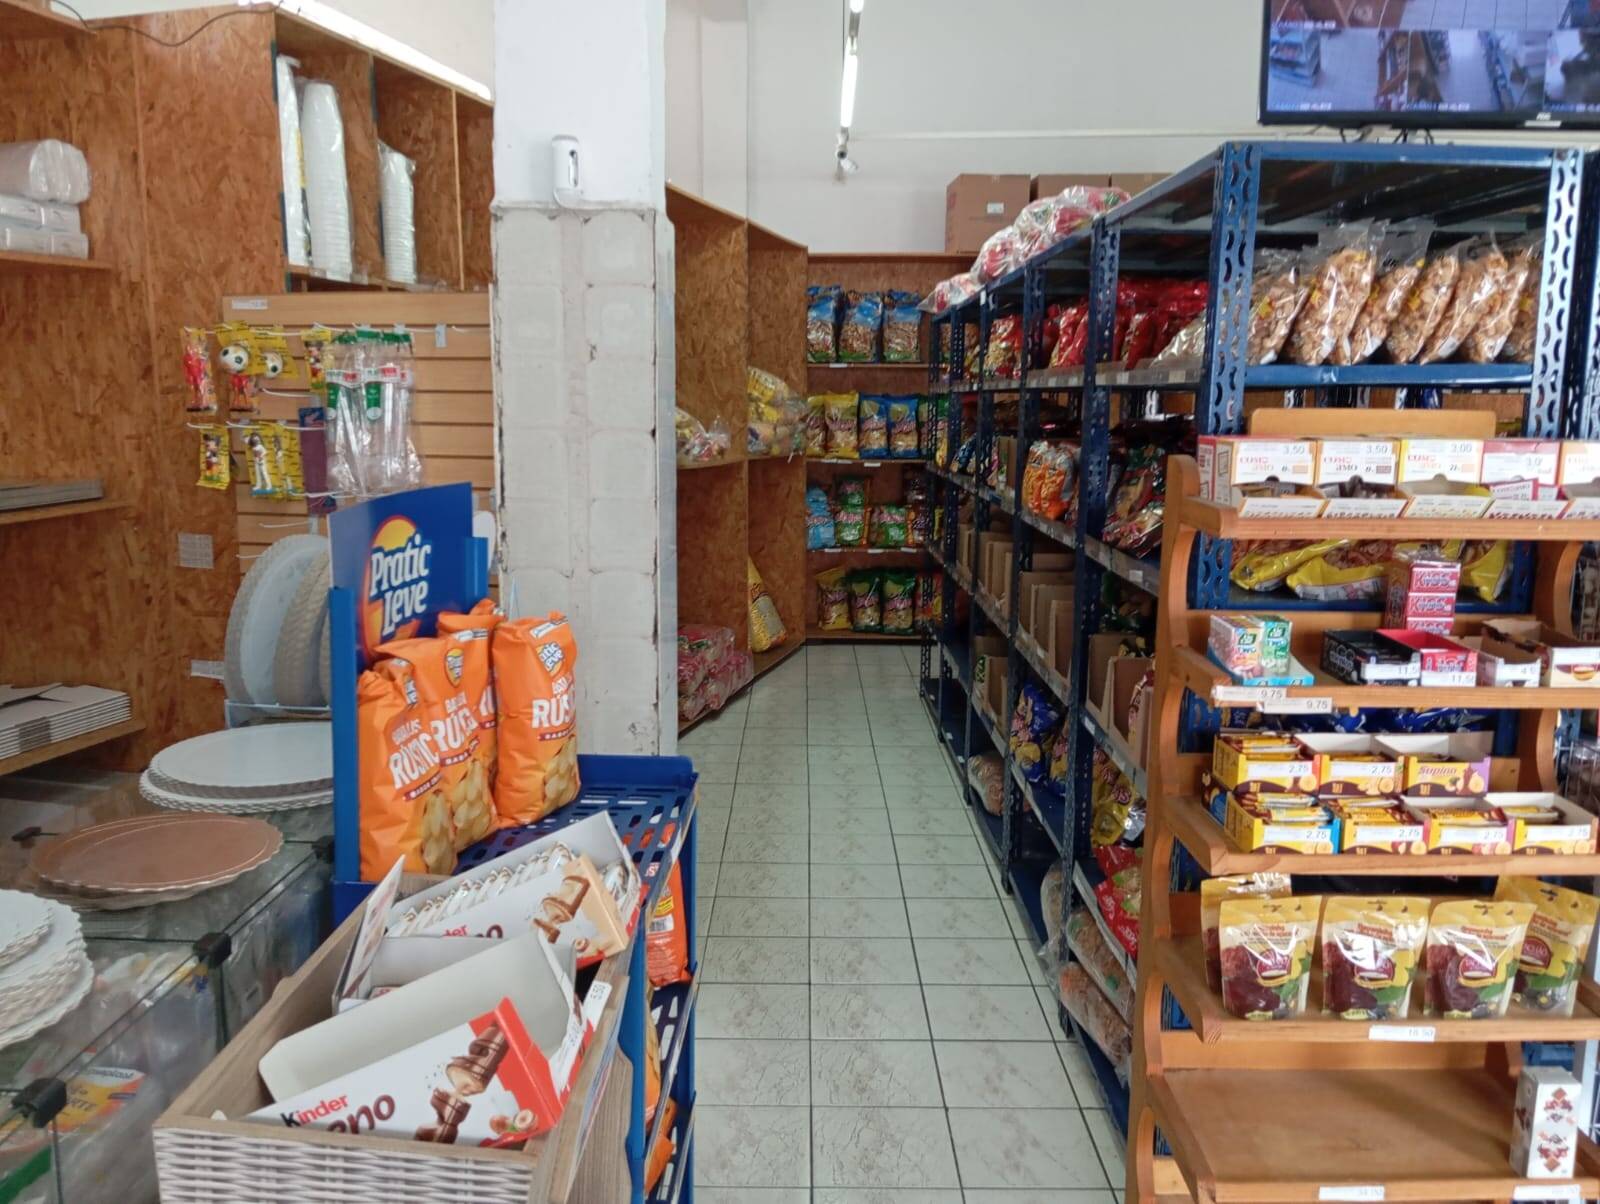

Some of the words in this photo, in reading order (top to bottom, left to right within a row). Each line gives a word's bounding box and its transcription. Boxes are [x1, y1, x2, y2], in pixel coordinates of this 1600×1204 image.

[369, 533, 432, 599] Pratic
[382, 579, 429, 637] Leve
[1418, 765, 1457, 776] Supino
[281, 1092, 349, 1128] Kinder
[327, 1094, 396, 1135] eno
